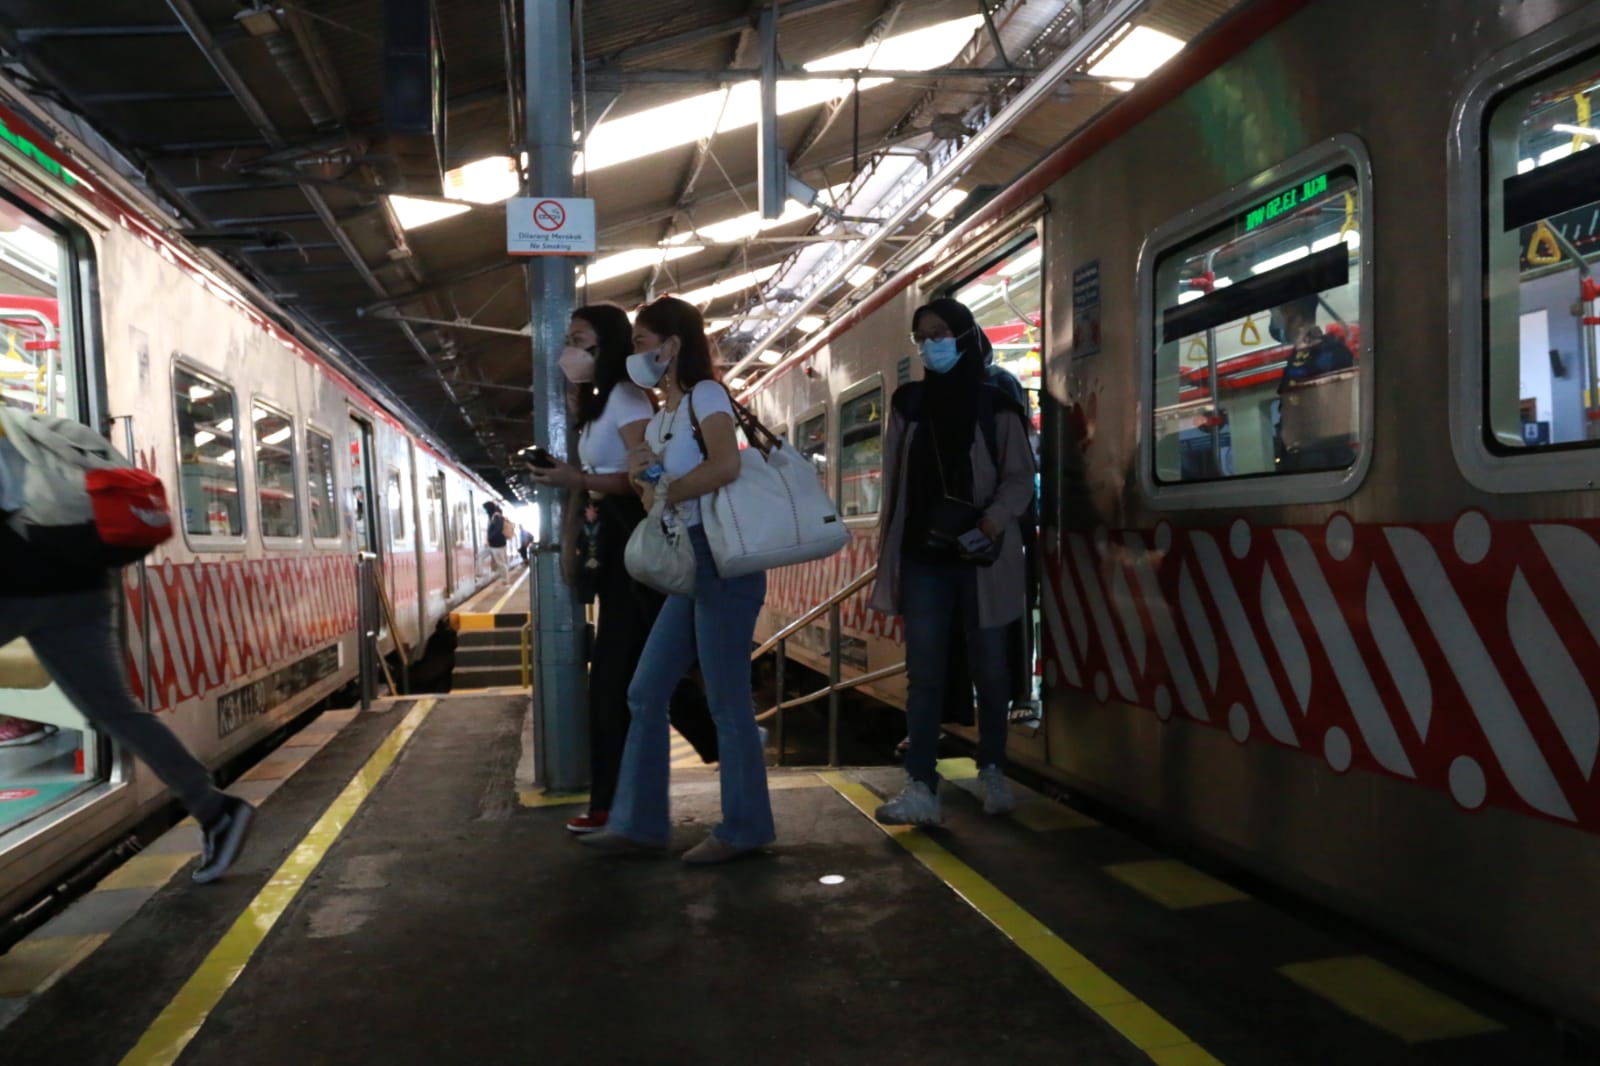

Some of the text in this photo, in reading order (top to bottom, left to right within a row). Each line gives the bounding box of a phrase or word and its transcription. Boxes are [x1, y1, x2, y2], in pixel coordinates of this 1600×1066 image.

[518, 231, 582, 241] Dilarang Merokok
[542, 242, 572, 250] Smoking
